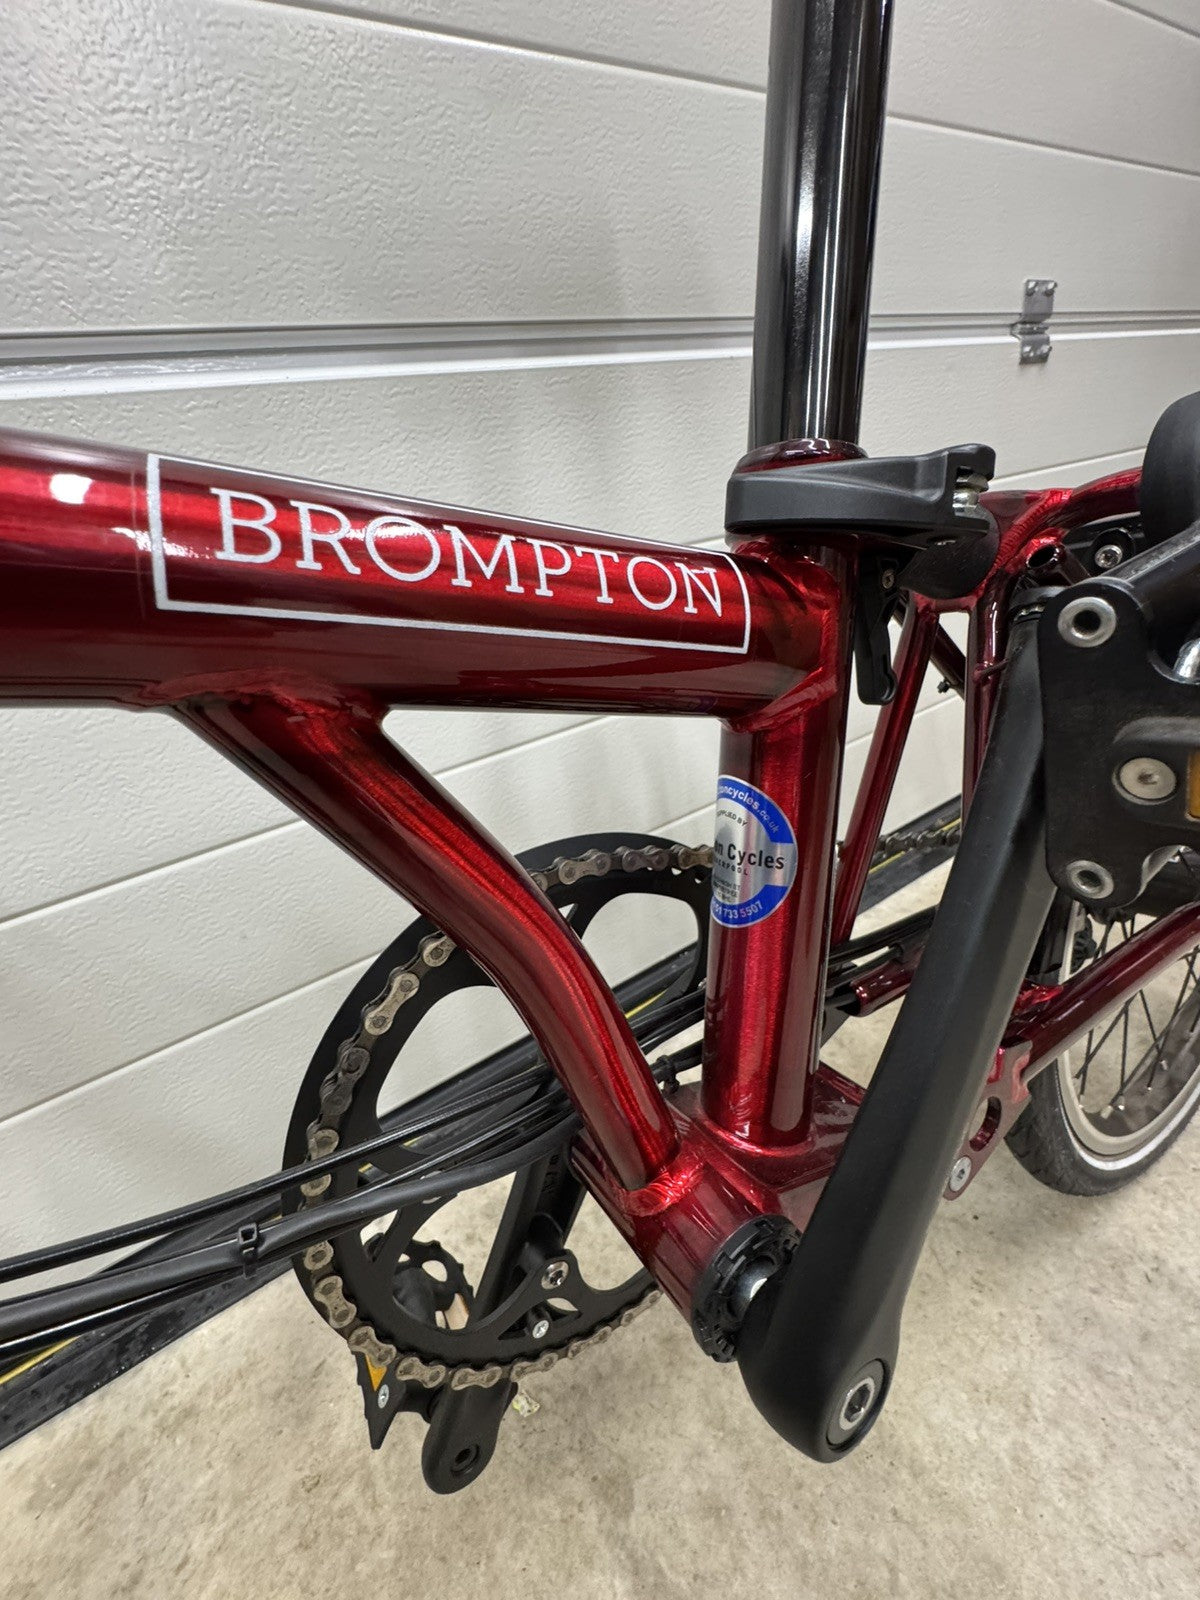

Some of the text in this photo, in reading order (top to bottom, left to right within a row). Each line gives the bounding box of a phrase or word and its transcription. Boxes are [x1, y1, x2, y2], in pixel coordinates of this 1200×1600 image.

[210, 487, 723, 618] BROMPTON
[727, 843, 785, 870] Cycles
[723, 908, 739, 919] 733
[739, 900, 763, 917] 5507
